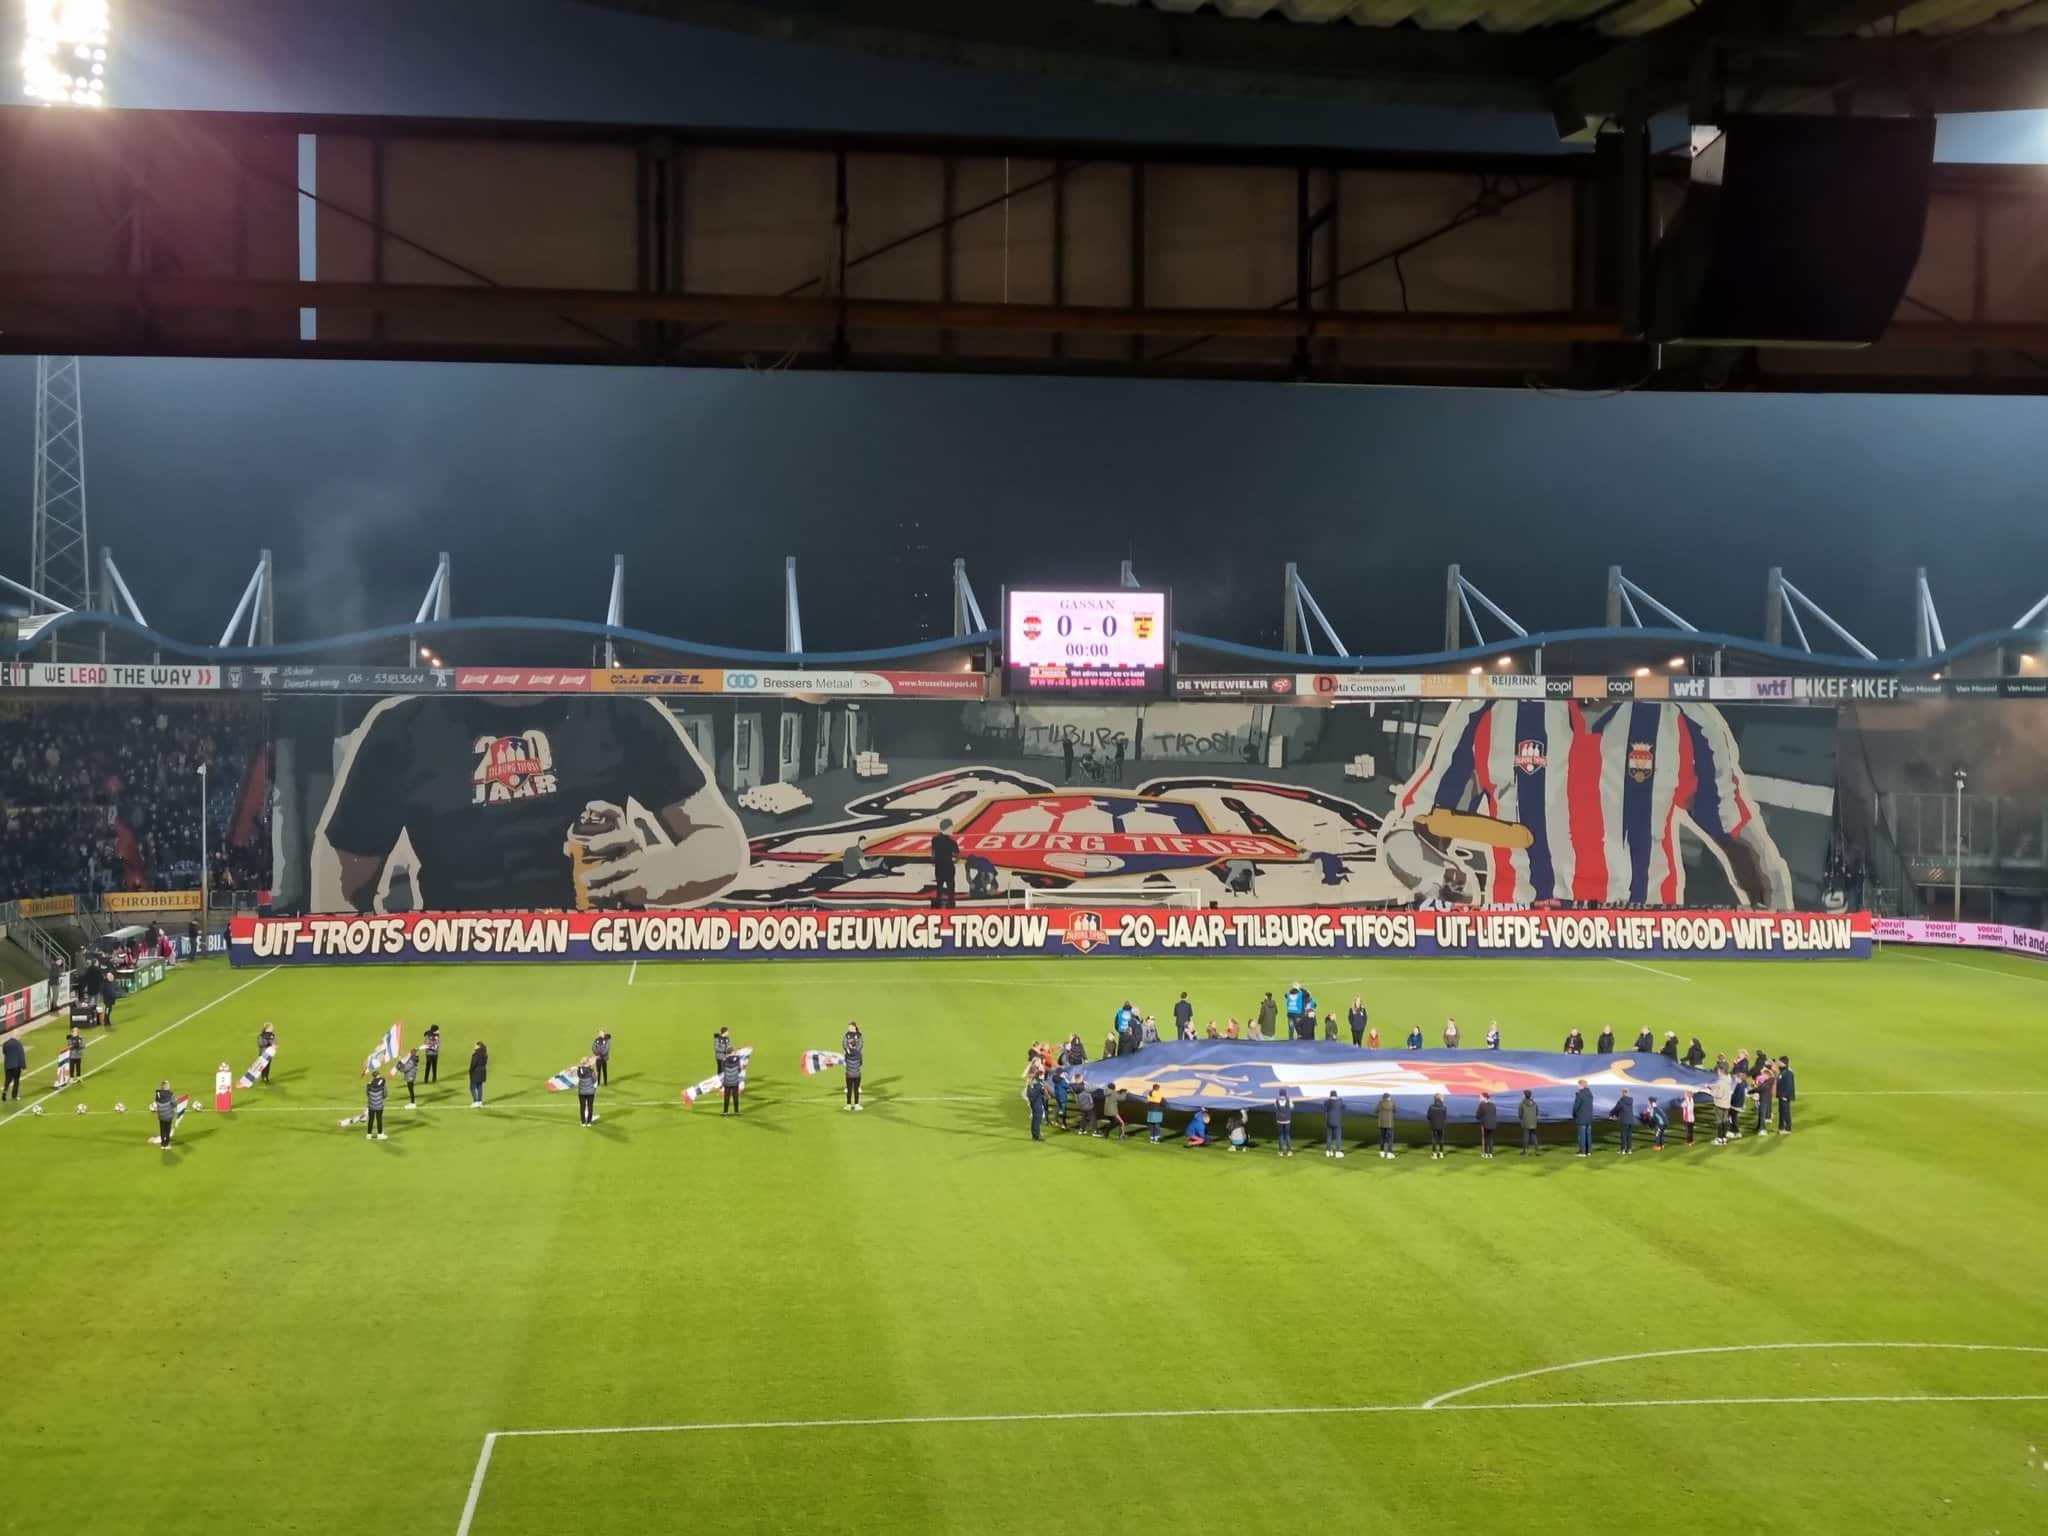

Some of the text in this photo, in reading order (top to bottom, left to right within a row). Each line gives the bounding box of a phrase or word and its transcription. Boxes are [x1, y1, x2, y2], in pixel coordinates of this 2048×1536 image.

[1059, 599, 1115, 610] GASSAN
[1057, 615, 1072, 637] 0
[1102, 616, 1117, 637] 0
[1065, 643, 1108, 657] 00:00
[45, 666, 192, 686] WE LEAD THE WAY
[642, 674, 704, 684] RIEL
[763, 677, 853, 688] Bressers Metaal
[1176, 680, 1268, 690] DE TWEEWIELER
[1673, 679, 1705, 697] wtf
[1757, 679, 1787, 697] wtf
[1030, 725, 1128, 750] TILBURG
[472, 775, 557, 803] JAAR
[1124, 836, 1277, 854] TIFOSI
[253, 914, 1048, 956] UIT TROTS ONTSTAAN GEVORMD DOOR EEUWIGE TROUW
[1120, 914, 1416, 948] 20 JAAR TILBURG TIFOSI
[1436, 915, 1852, 950] UIT LIEFDE VOOR HET ROOD WIT BLAUW
[1925, 922, 1957, 930] vooruit
[2013, 929, 2027, 946] het
